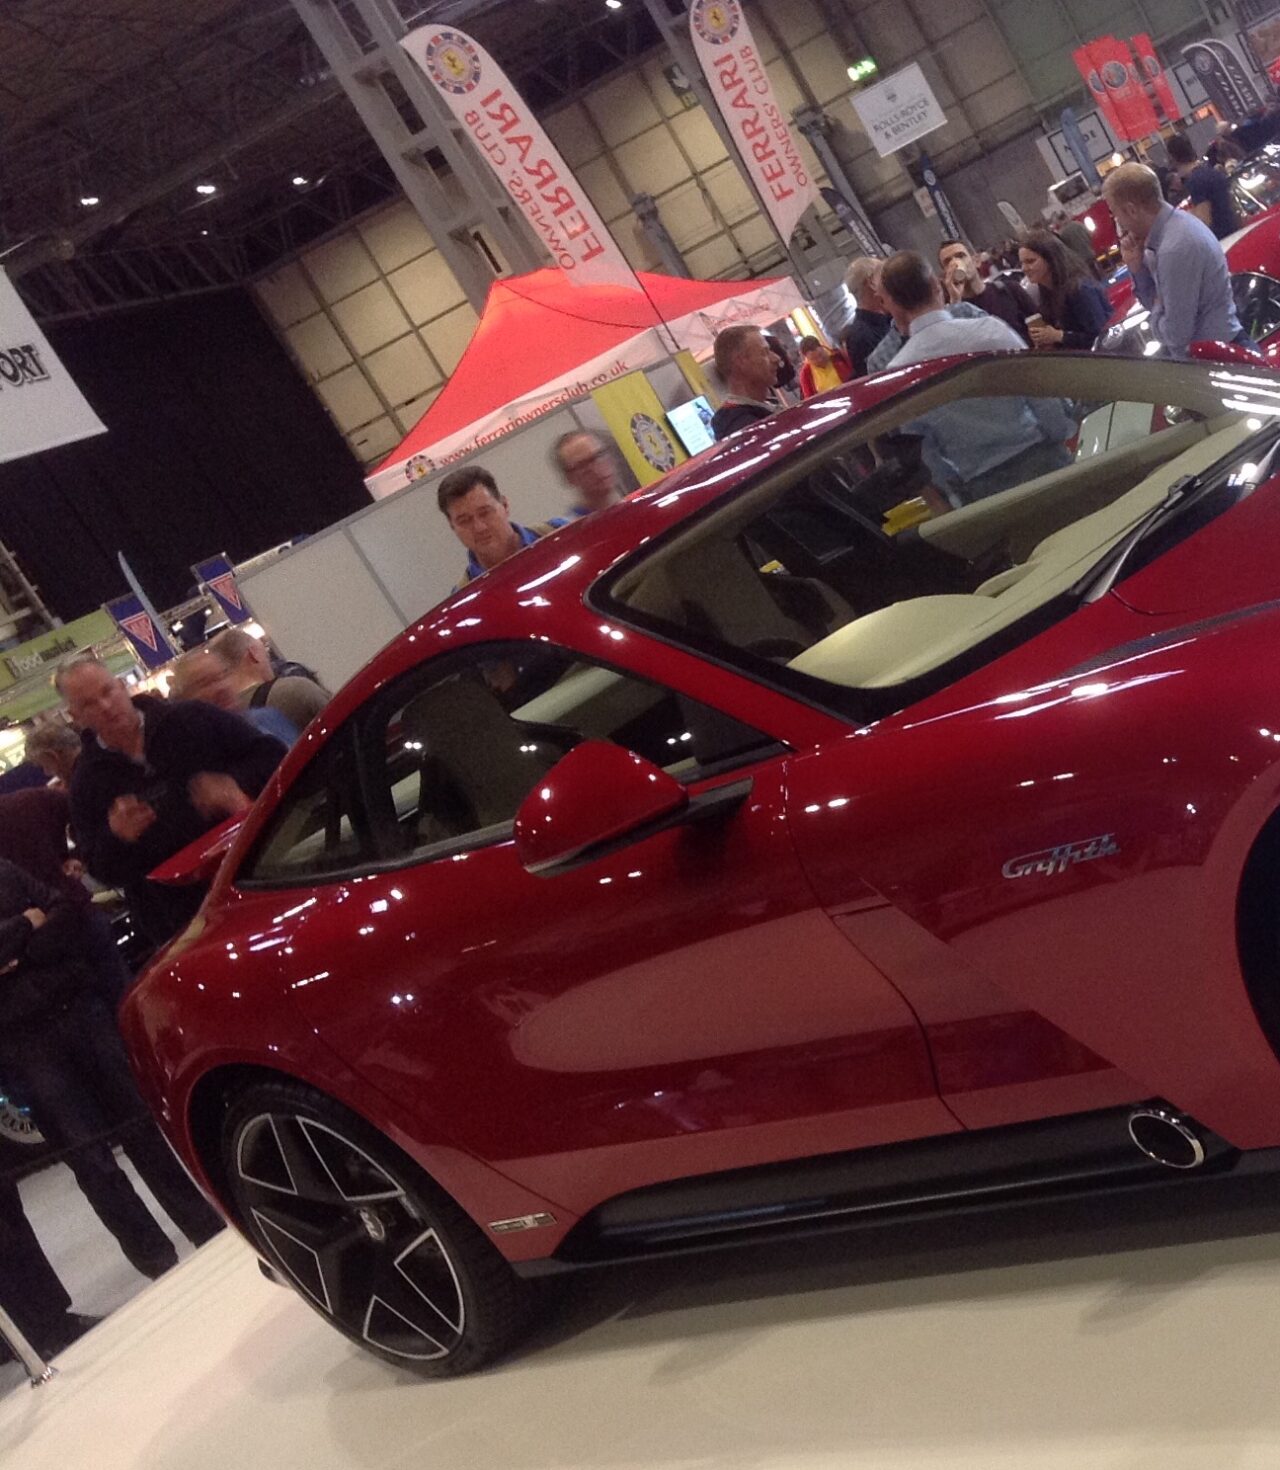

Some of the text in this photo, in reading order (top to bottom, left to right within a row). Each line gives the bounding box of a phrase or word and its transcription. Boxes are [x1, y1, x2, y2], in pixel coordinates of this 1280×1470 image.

[713, 53, 795, 202] FERRARI
[740, 45, 808, 187] OWNERS' CLUB
[872, 97, 930, 132] ROLLS-ROYCE
[890, 109, 928, 135] BENTLEY
